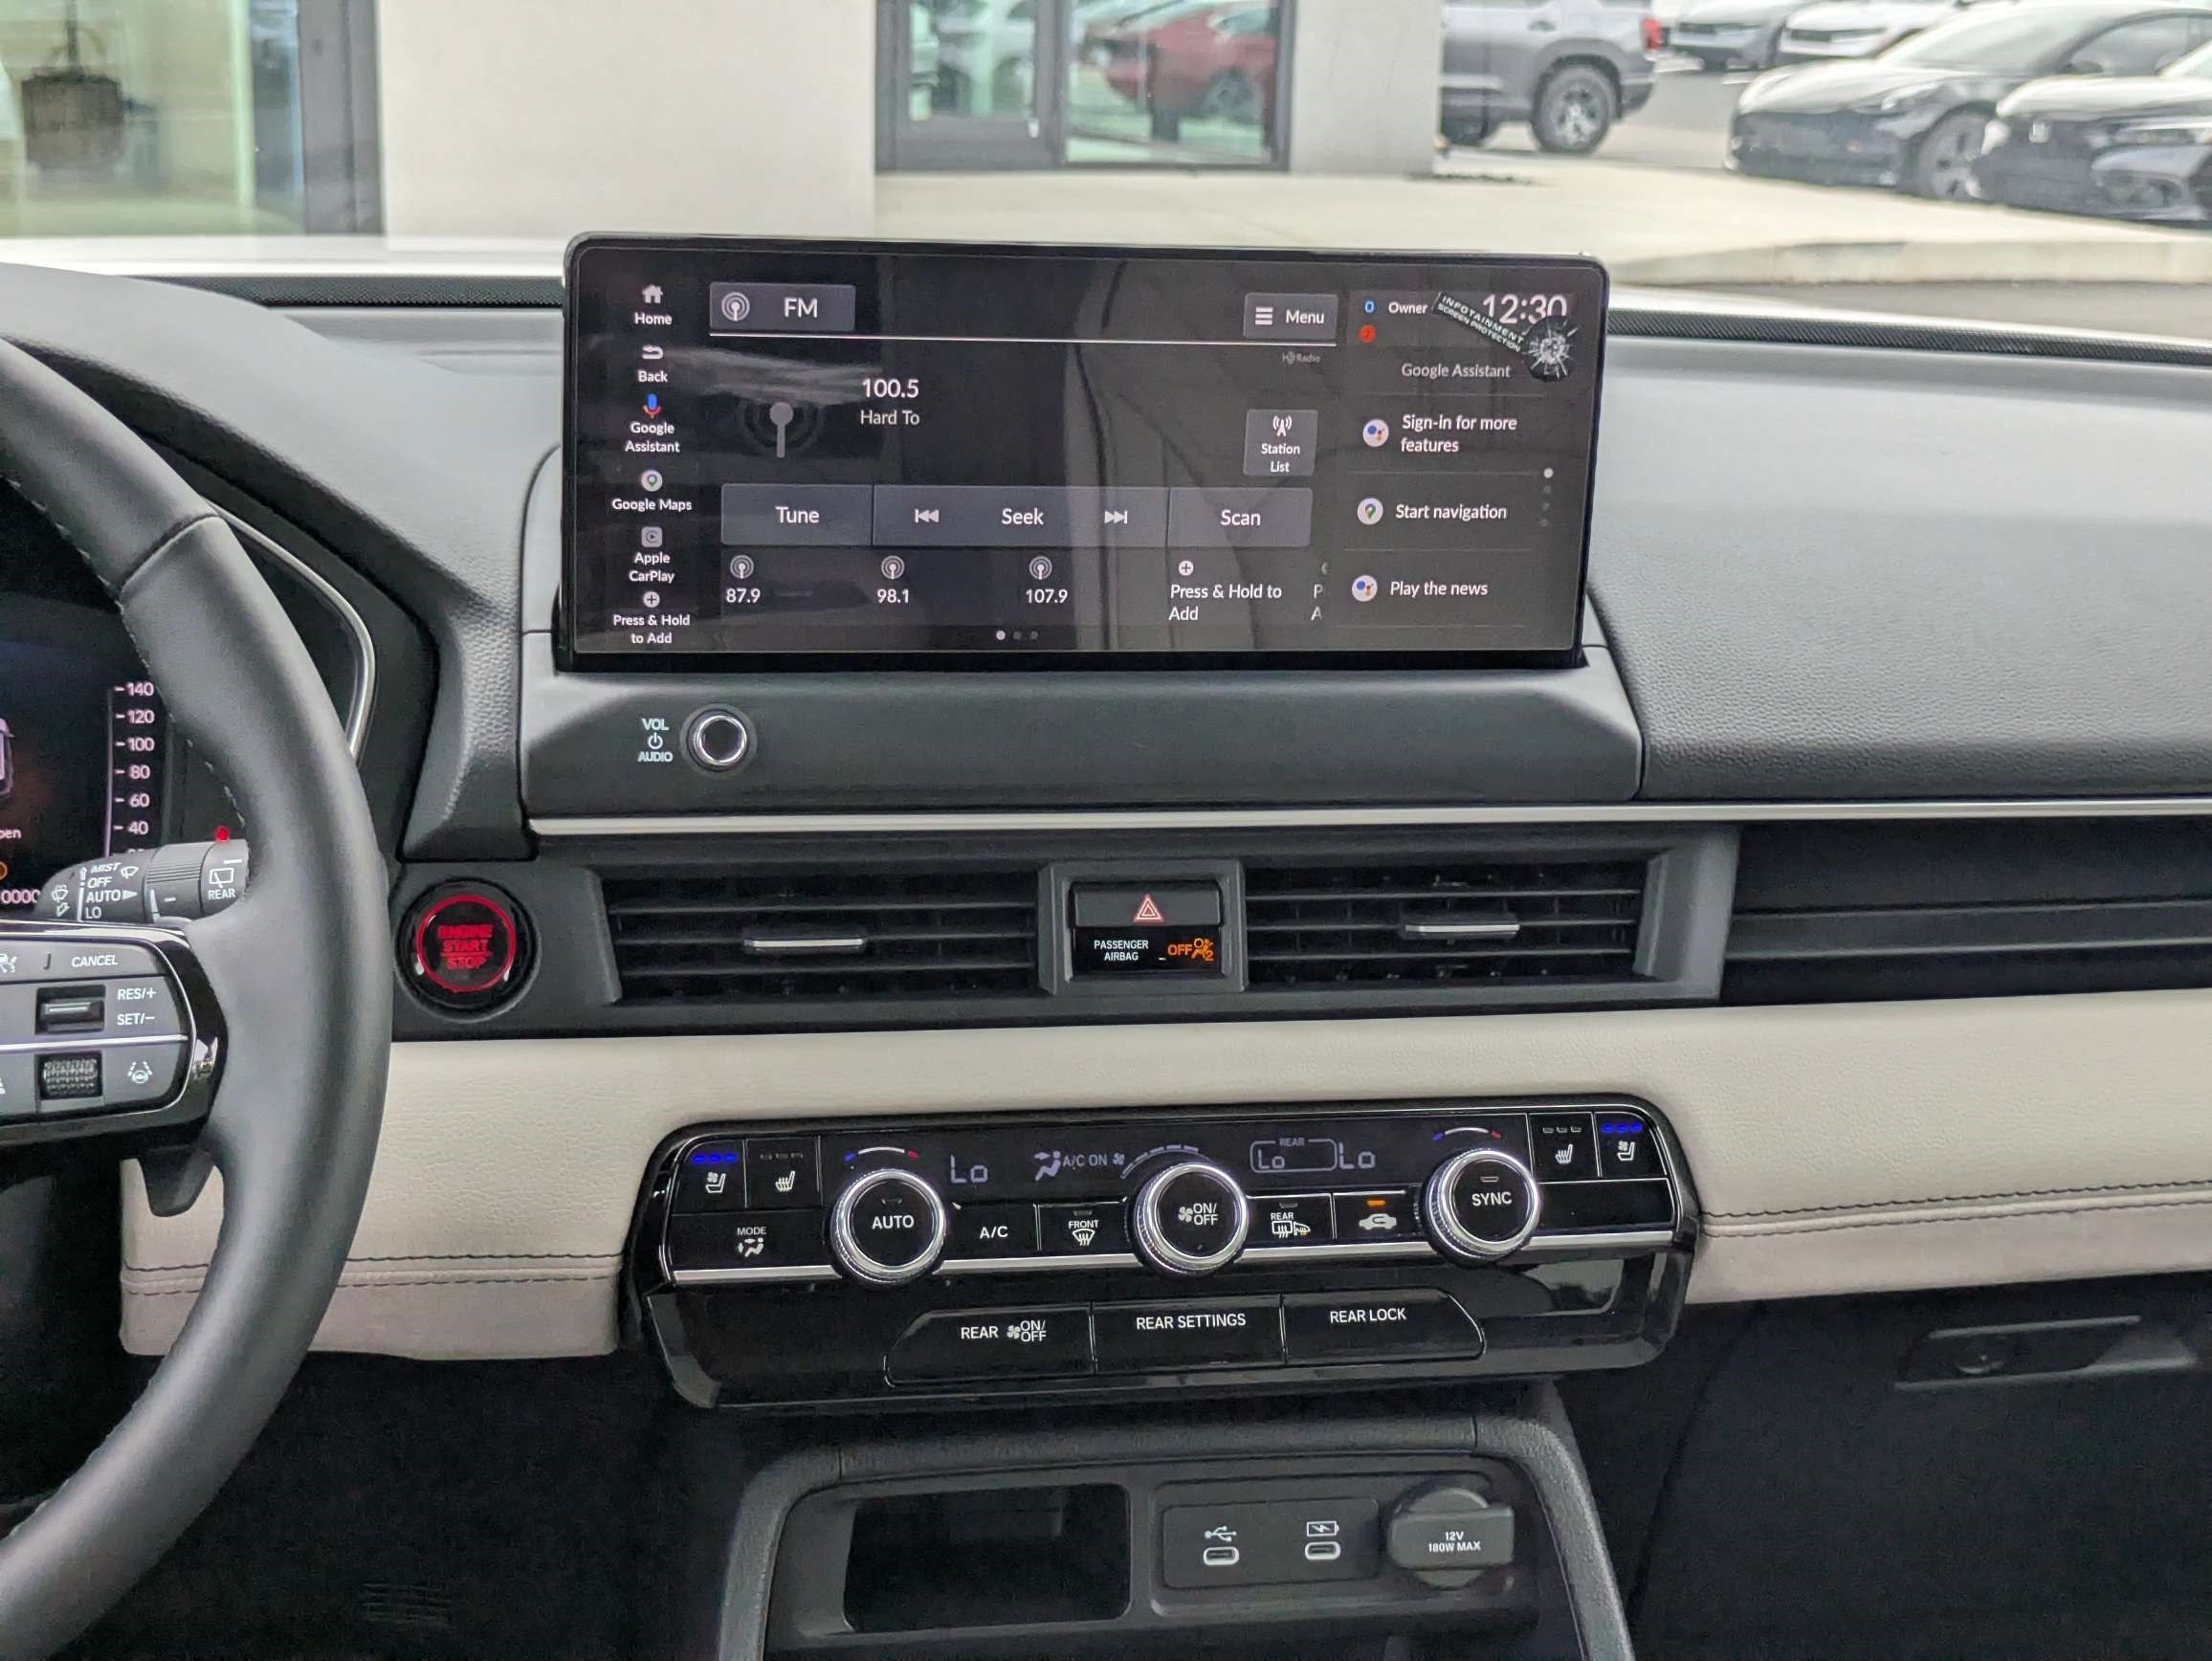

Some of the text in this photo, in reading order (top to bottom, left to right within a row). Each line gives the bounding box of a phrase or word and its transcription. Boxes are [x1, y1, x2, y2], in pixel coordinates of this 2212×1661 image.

[784, 299, 818, 318] FM
[1388, 302, 1427, 314] Owner
[1483, 295, 1568, 324] 12:30
[634, 313, 673, 325] Home
[1286, 310, 1325, 324] Menu
[1442, 296, 1525, 343] INFOTAINMENT
[638, 370, 668, 383] Back
[1402, 364, 1511, 378] Google Assistant
[862, 379, 919, 398] 100.5
[861, 410, 919, 425] Hard To
[1403, 414, 1517, 432] Sign-in for more
[630, 423, 675, 436] Google
[625, 440, 680, 453] Assistant
[1261, 443, 1300, 454] Station
[1401, 437, 1459, 453] features
[1270, 461, 1290, 473] List
[611, 498, 692, 512] Google Maps
[1396, 503, 1507, 520] Start navigation
[776, 507, 820, 523] Tune
[1002, 509, 1044, 525] Seek
[1221, 510, 1261, 526] Scan
[634, 552, 671, 565] Apple
[630, 570, 675, 584] CarPlay
[1171, 584, 1282, 599] Press & Hold to
[1390, 580, 1488, 597] Play the news
[726, 588, 761, 604] 87.9
[877, 588, 909, 604] 98.1
[1026, 588, 1068, 604] 107.9
[613, 614, 691, 628] Press & Hold
[1169, 607, 1199, 622] Add
[631, 632, 673, 645] to Add
[127, 683, 154, 698] 140
[128, 710, 154, 724] 120
[642, 719, 670, 731] VOL
[128, 738, 154, 751] 100
[638, 751, 673, 763] AUDIO
[129, 765, 150, 780] 80
[129, 793, 150, 808] 60
[128, 821, 149, 835] 40
[91, 862, 122, 874] MIST
[87, 876, 112, 889] OFF
[86, 890, 121, 903] AUTO
[208, 889, 235, 900] REAR
[85, 906, 101, 919] LO
[443, 940, 490, 952] START
[1094, 940, 1192, 957] PASSENGER OFF
[72, 955, 118, 967] CANCEL
[447, 957, 487, 970] STOP
[1104, 951, 1139, 962] AIRBAG
[118, 987, 156, 1001] RES/+
[1280, 1138, 1305, 1146] REAR
[1062, 1154, 1107, 1167] A/C ON
[1339, 1142, 1375, 1168] Lo
[950, 1156, 987, 1184] Lo
[1471, 1192, 1512, 1207] SYNC
[1193, 1203, 1218, 1214] ON/
[872, 1214, 915, 1229] AUTO
[1193, 1213, 1218, 1226] OFF
[1271, 1212, 1294, 1221] REAR
[737, 1227, 766, 1236] MODE
[1068, 1219, 1099, 1230] FRONT
[980, 1225, 1008, 1239] A/C
[1136, 1314, 1246, 1330] REAR SETTINGS
[1330, 1308, 1406, 1324] REAR LOCK
[961, 1321, 1046, 1340] REAR ON/
[1021, 1331, 1047, 1342] OFF
[1445, 1531, 1464, 1541] 12V
[1456, 1540, 1481, 1551] MAX
